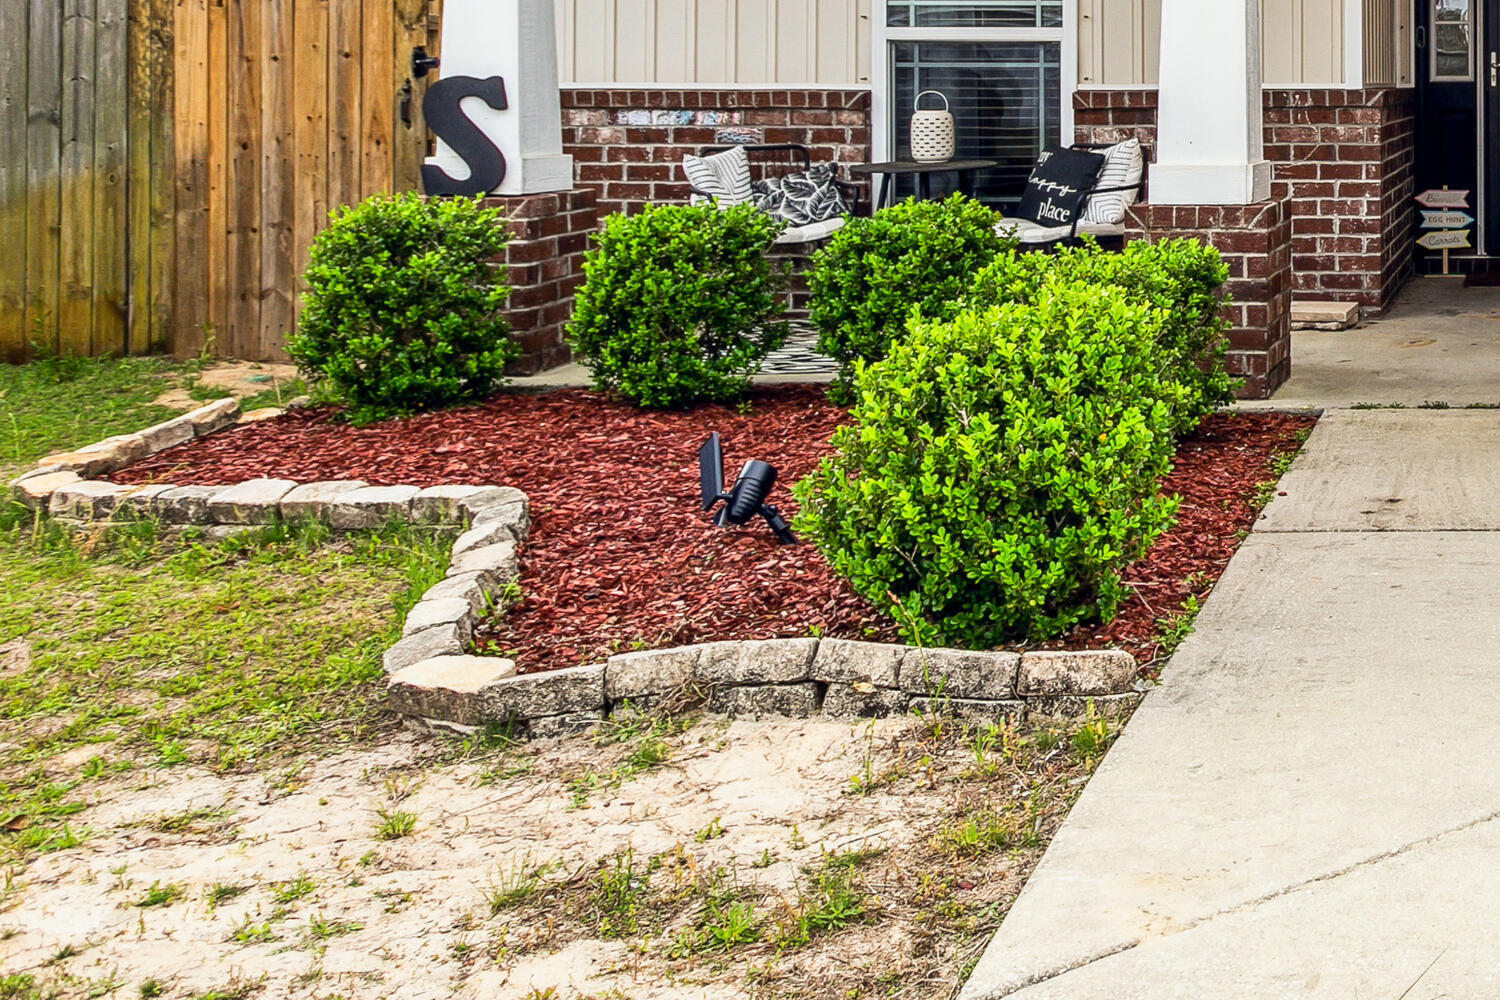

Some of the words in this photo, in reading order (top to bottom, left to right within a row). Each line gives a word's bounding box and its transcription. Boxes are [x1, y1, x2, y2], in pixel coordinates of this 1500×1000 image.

[419, 75, 508, 197] S
[1036, 197, 1071, 222] place
[1428, 216, 1444, 224] EGG
[1446, 216, 1466, 224] HUNT
